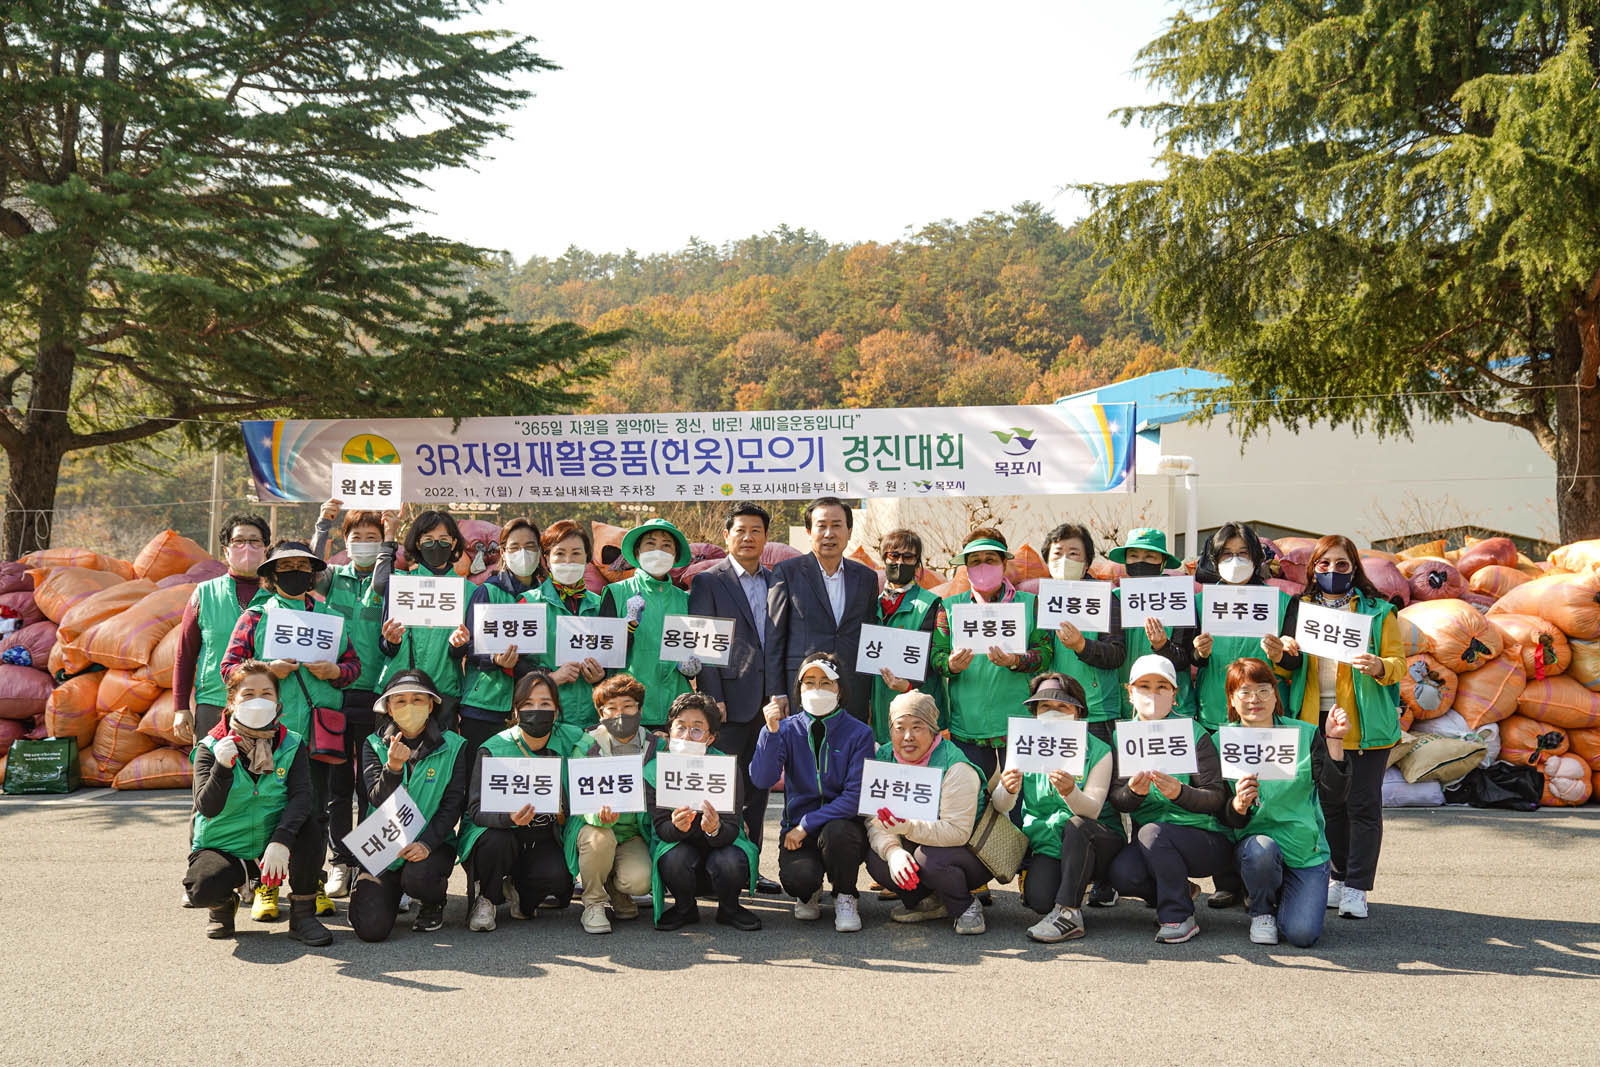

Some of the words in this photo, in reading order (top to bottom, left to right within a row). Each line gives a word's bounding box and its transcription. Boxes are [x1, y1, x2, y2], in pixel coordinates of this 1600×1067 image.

[569, 419, 609, 436] 자원을
[615, 418, 669, 435] 절약하는
[712, 416, 743, 433] 바로!
[842, 432, 964, 473] 경진대회
[994, 460, 1041, 478] 목포시
[340, 478, 393, 497] 원산동
[529, 485, 614, 497] 목포실내체육관
[619, 484, 656, 497] 주차장
[738, 481, 849, 495] 목포시새마을부녀회
[935, 480, 966, 491] 목포시
[395, 591, 457, 612] 죽교동
[1047, 595, 1101, 616] 신흥동
[1127, 591, 1188, 612] 하당동
[1211, 601, 1269, 621] 부주동
[274, 624, 334, 650] 동명동
[482, 619, 539, 638] 북항동
[962, 619, 1017, 638] 부흥동
[1303, 619, 1362, 649] 옥암동
[569, 633, 614, 651] 산정동
[663, 629, 731, 651] 용당1동
[1015, 735, 1079, 758] 삼향동
[1125, 735, 1188, 759] 이로동
[1222, 742, 1296, 765] 용당2동
[488, 774, 553, 796] 목원동
[577, 774, 634, 796] 연산동
[664, 770, 727, 794] 만호동
[869, 778, 933, 804] 삼학동
[360, 803, 415, 858] 대성동
